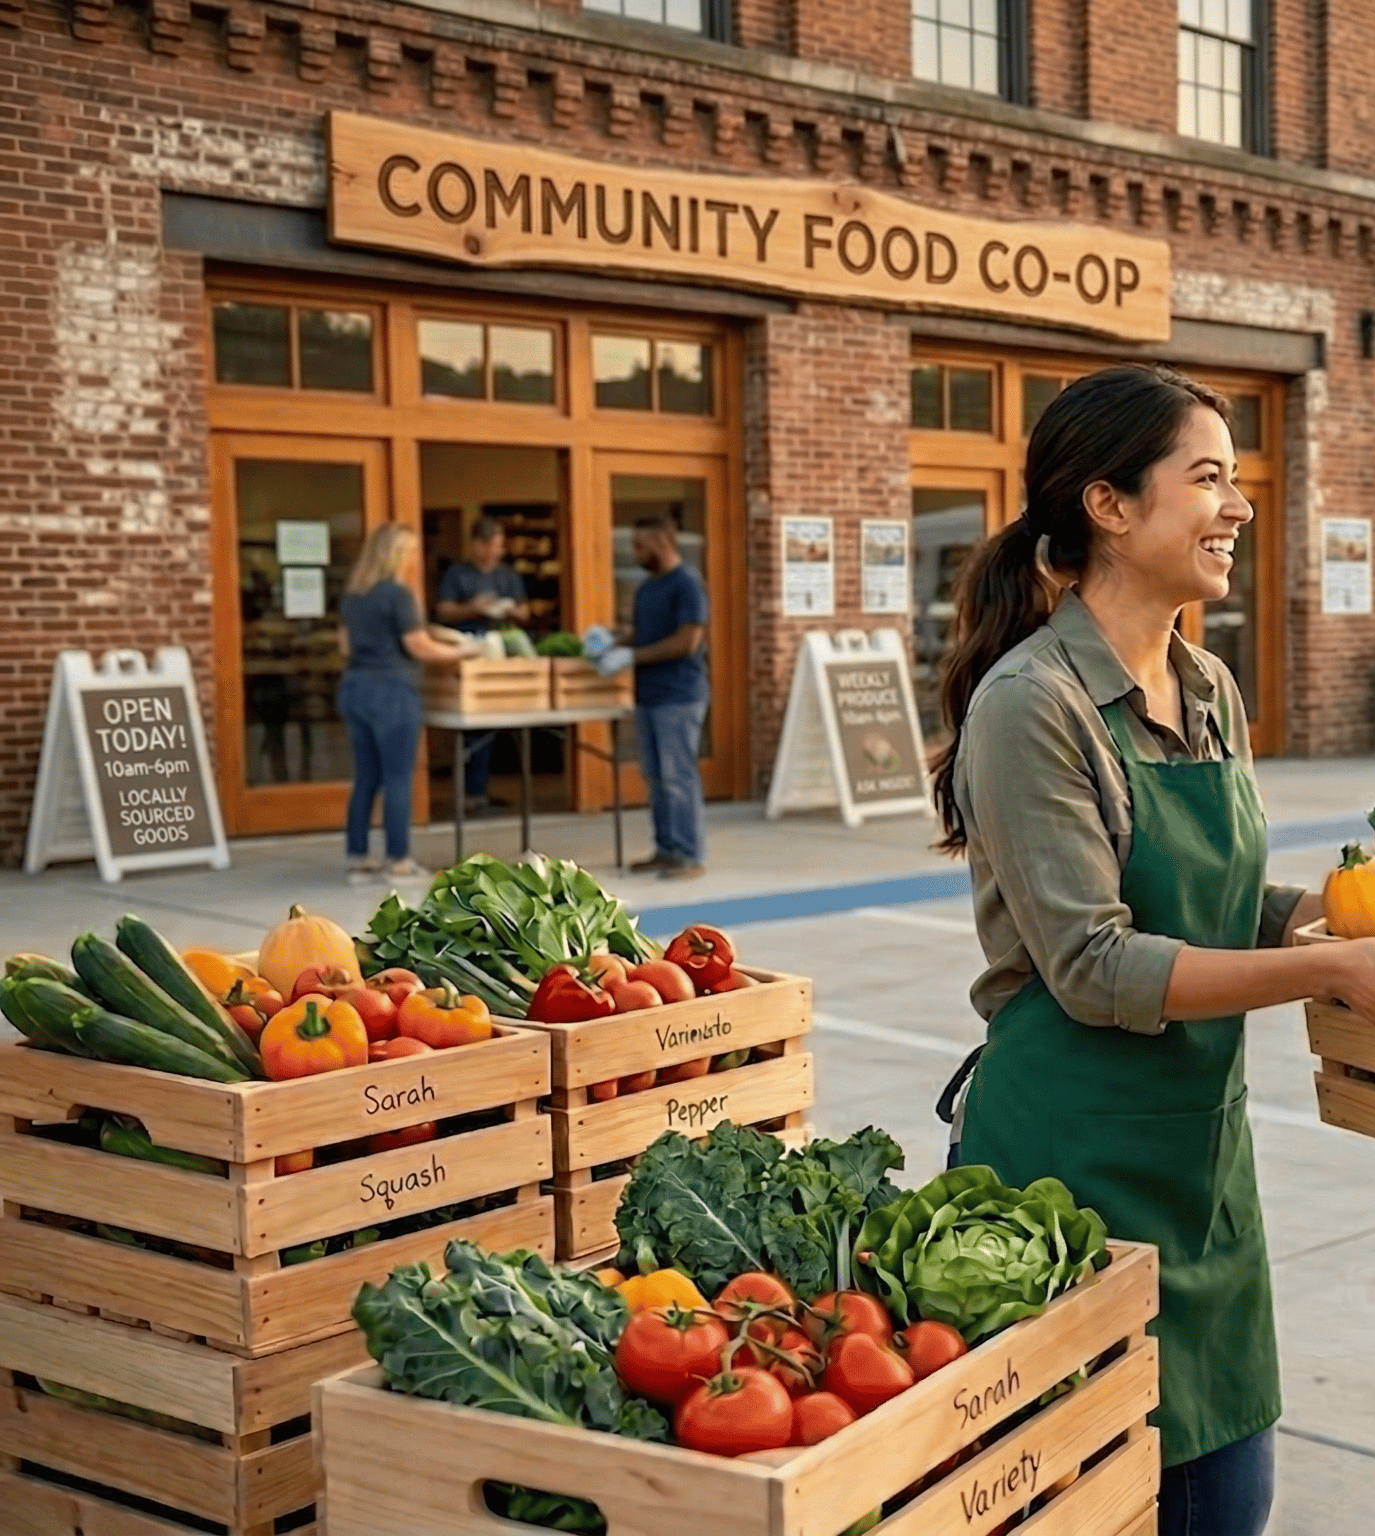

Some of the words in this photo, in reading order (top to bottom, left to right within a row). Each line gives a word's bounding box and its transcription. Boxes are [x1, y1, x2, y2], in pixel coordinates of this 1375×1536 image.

[376, 154, 780, 262] COMMUNITY
[803, 216, 959, 285] FOOD
[978, 239, 1141, 307] CO-OP
[103, 697, 172, 724] OPEN
[95, 725, 187, 753] TODAY!
[104, 759, 190, 778] 10am-6pm
[119, 786, 188, 807] LOCALLY
[120, 806, 195, 826] SOURCED
[133, 825, 189, 845] GOODS
[364, 1076, 436, 1115] Sarah
[666, 1093, 729, 1127] Pepper
[360, 1154, 446, 1210] Squash
[953, 1357, 1020, 1430] Sarah
[960, 1449, 1042, 1524] Variety
